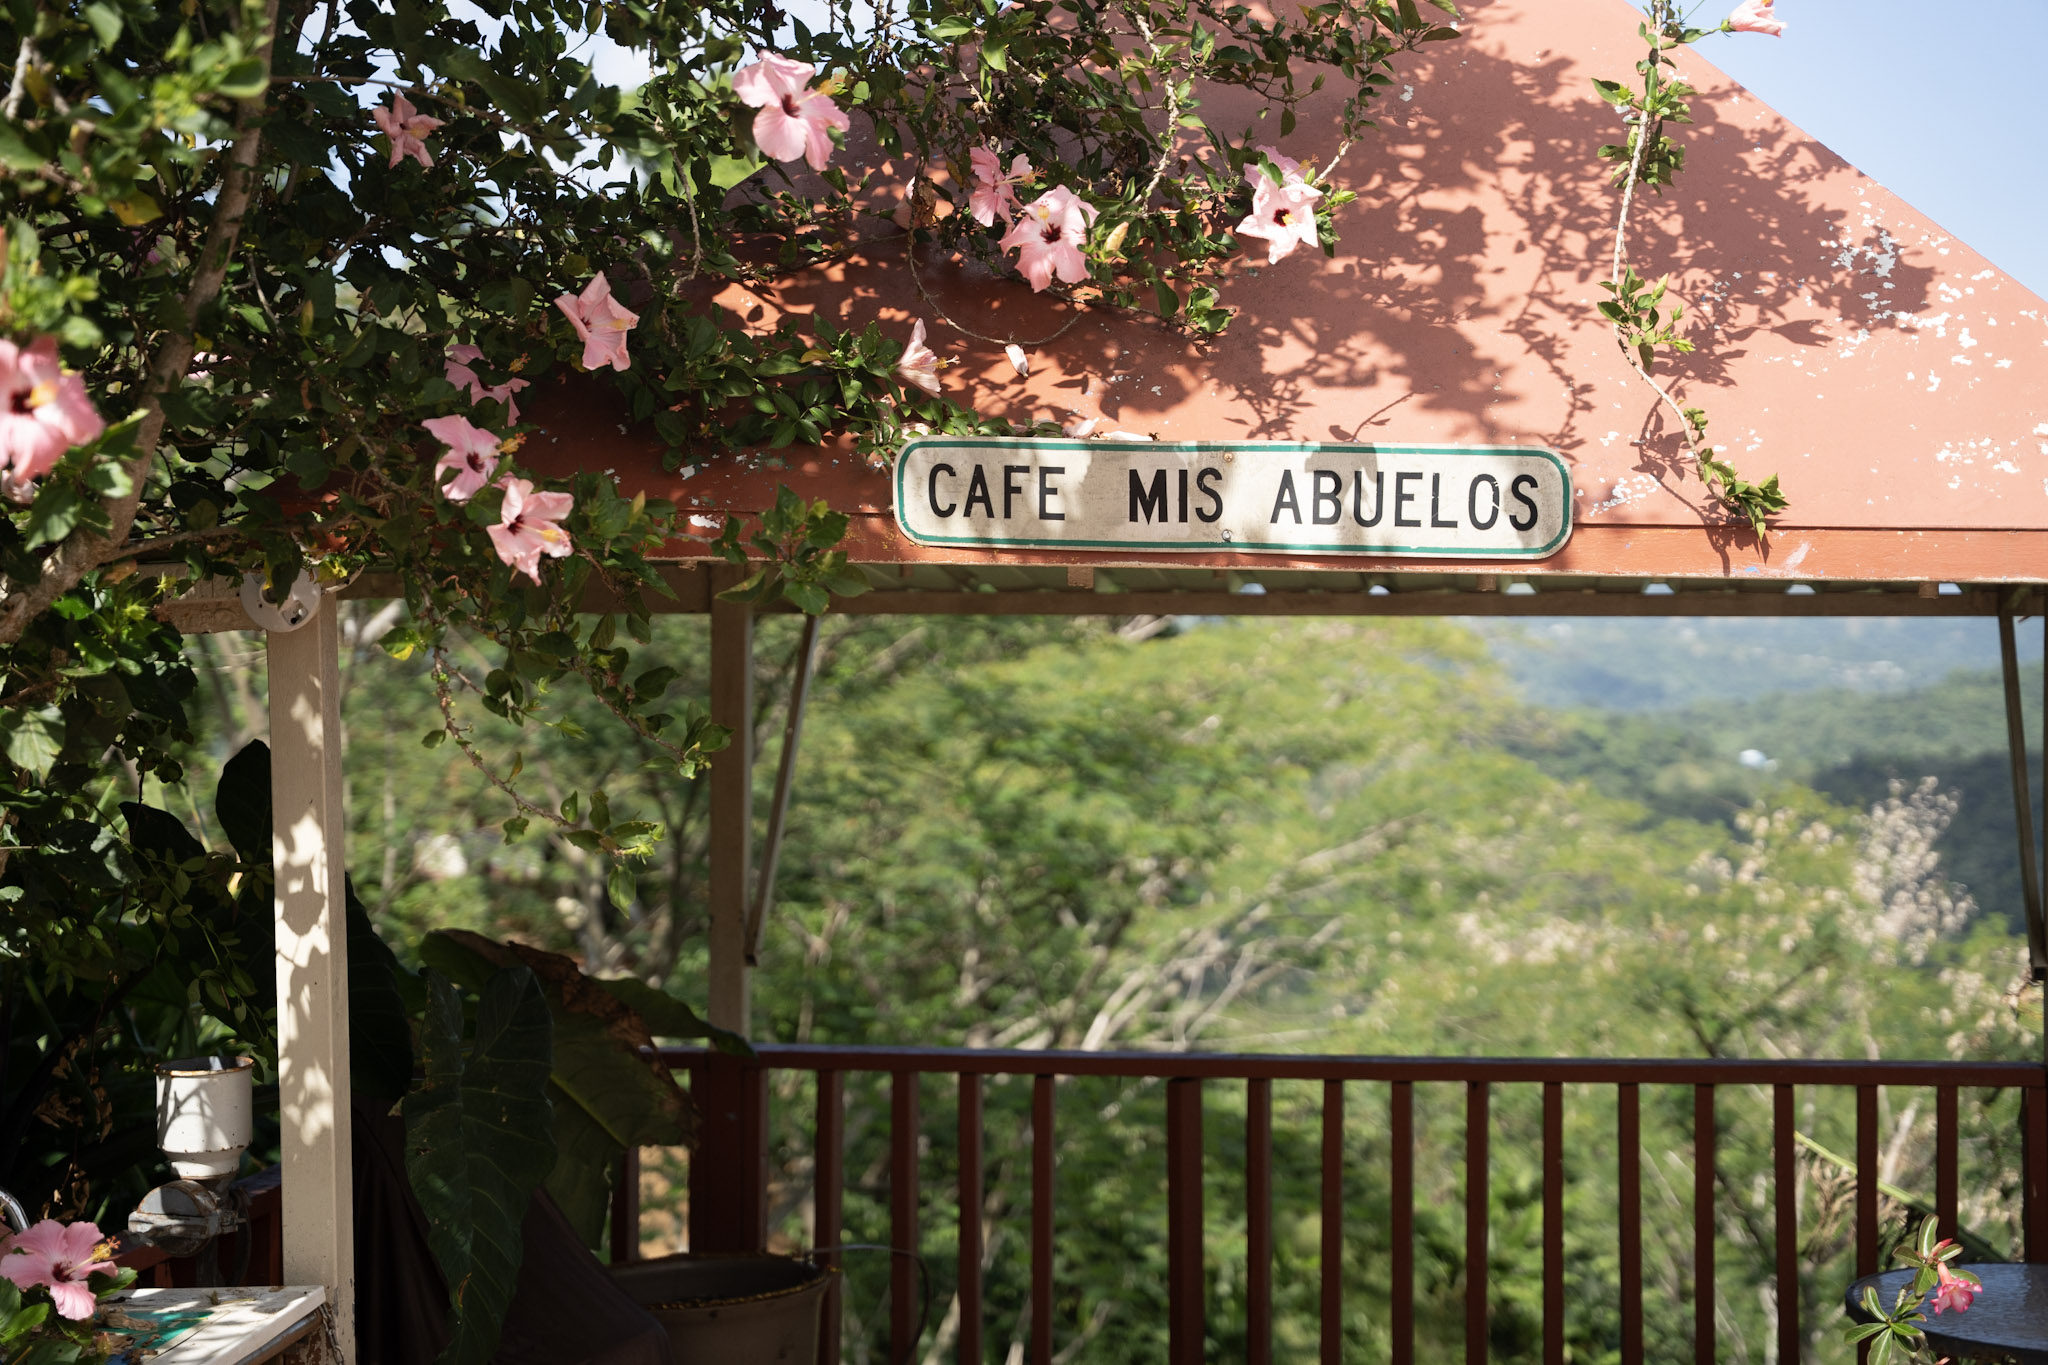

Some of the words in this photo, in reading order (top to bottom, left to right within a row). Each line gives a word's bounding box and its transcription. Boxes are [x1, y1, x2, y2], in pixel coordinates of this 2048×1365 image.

[928, 463, 1066, 521] CAFE
[1128, 467, 1224, 524] MIS
[1270, 469, 1539, 531] ABUELOS
